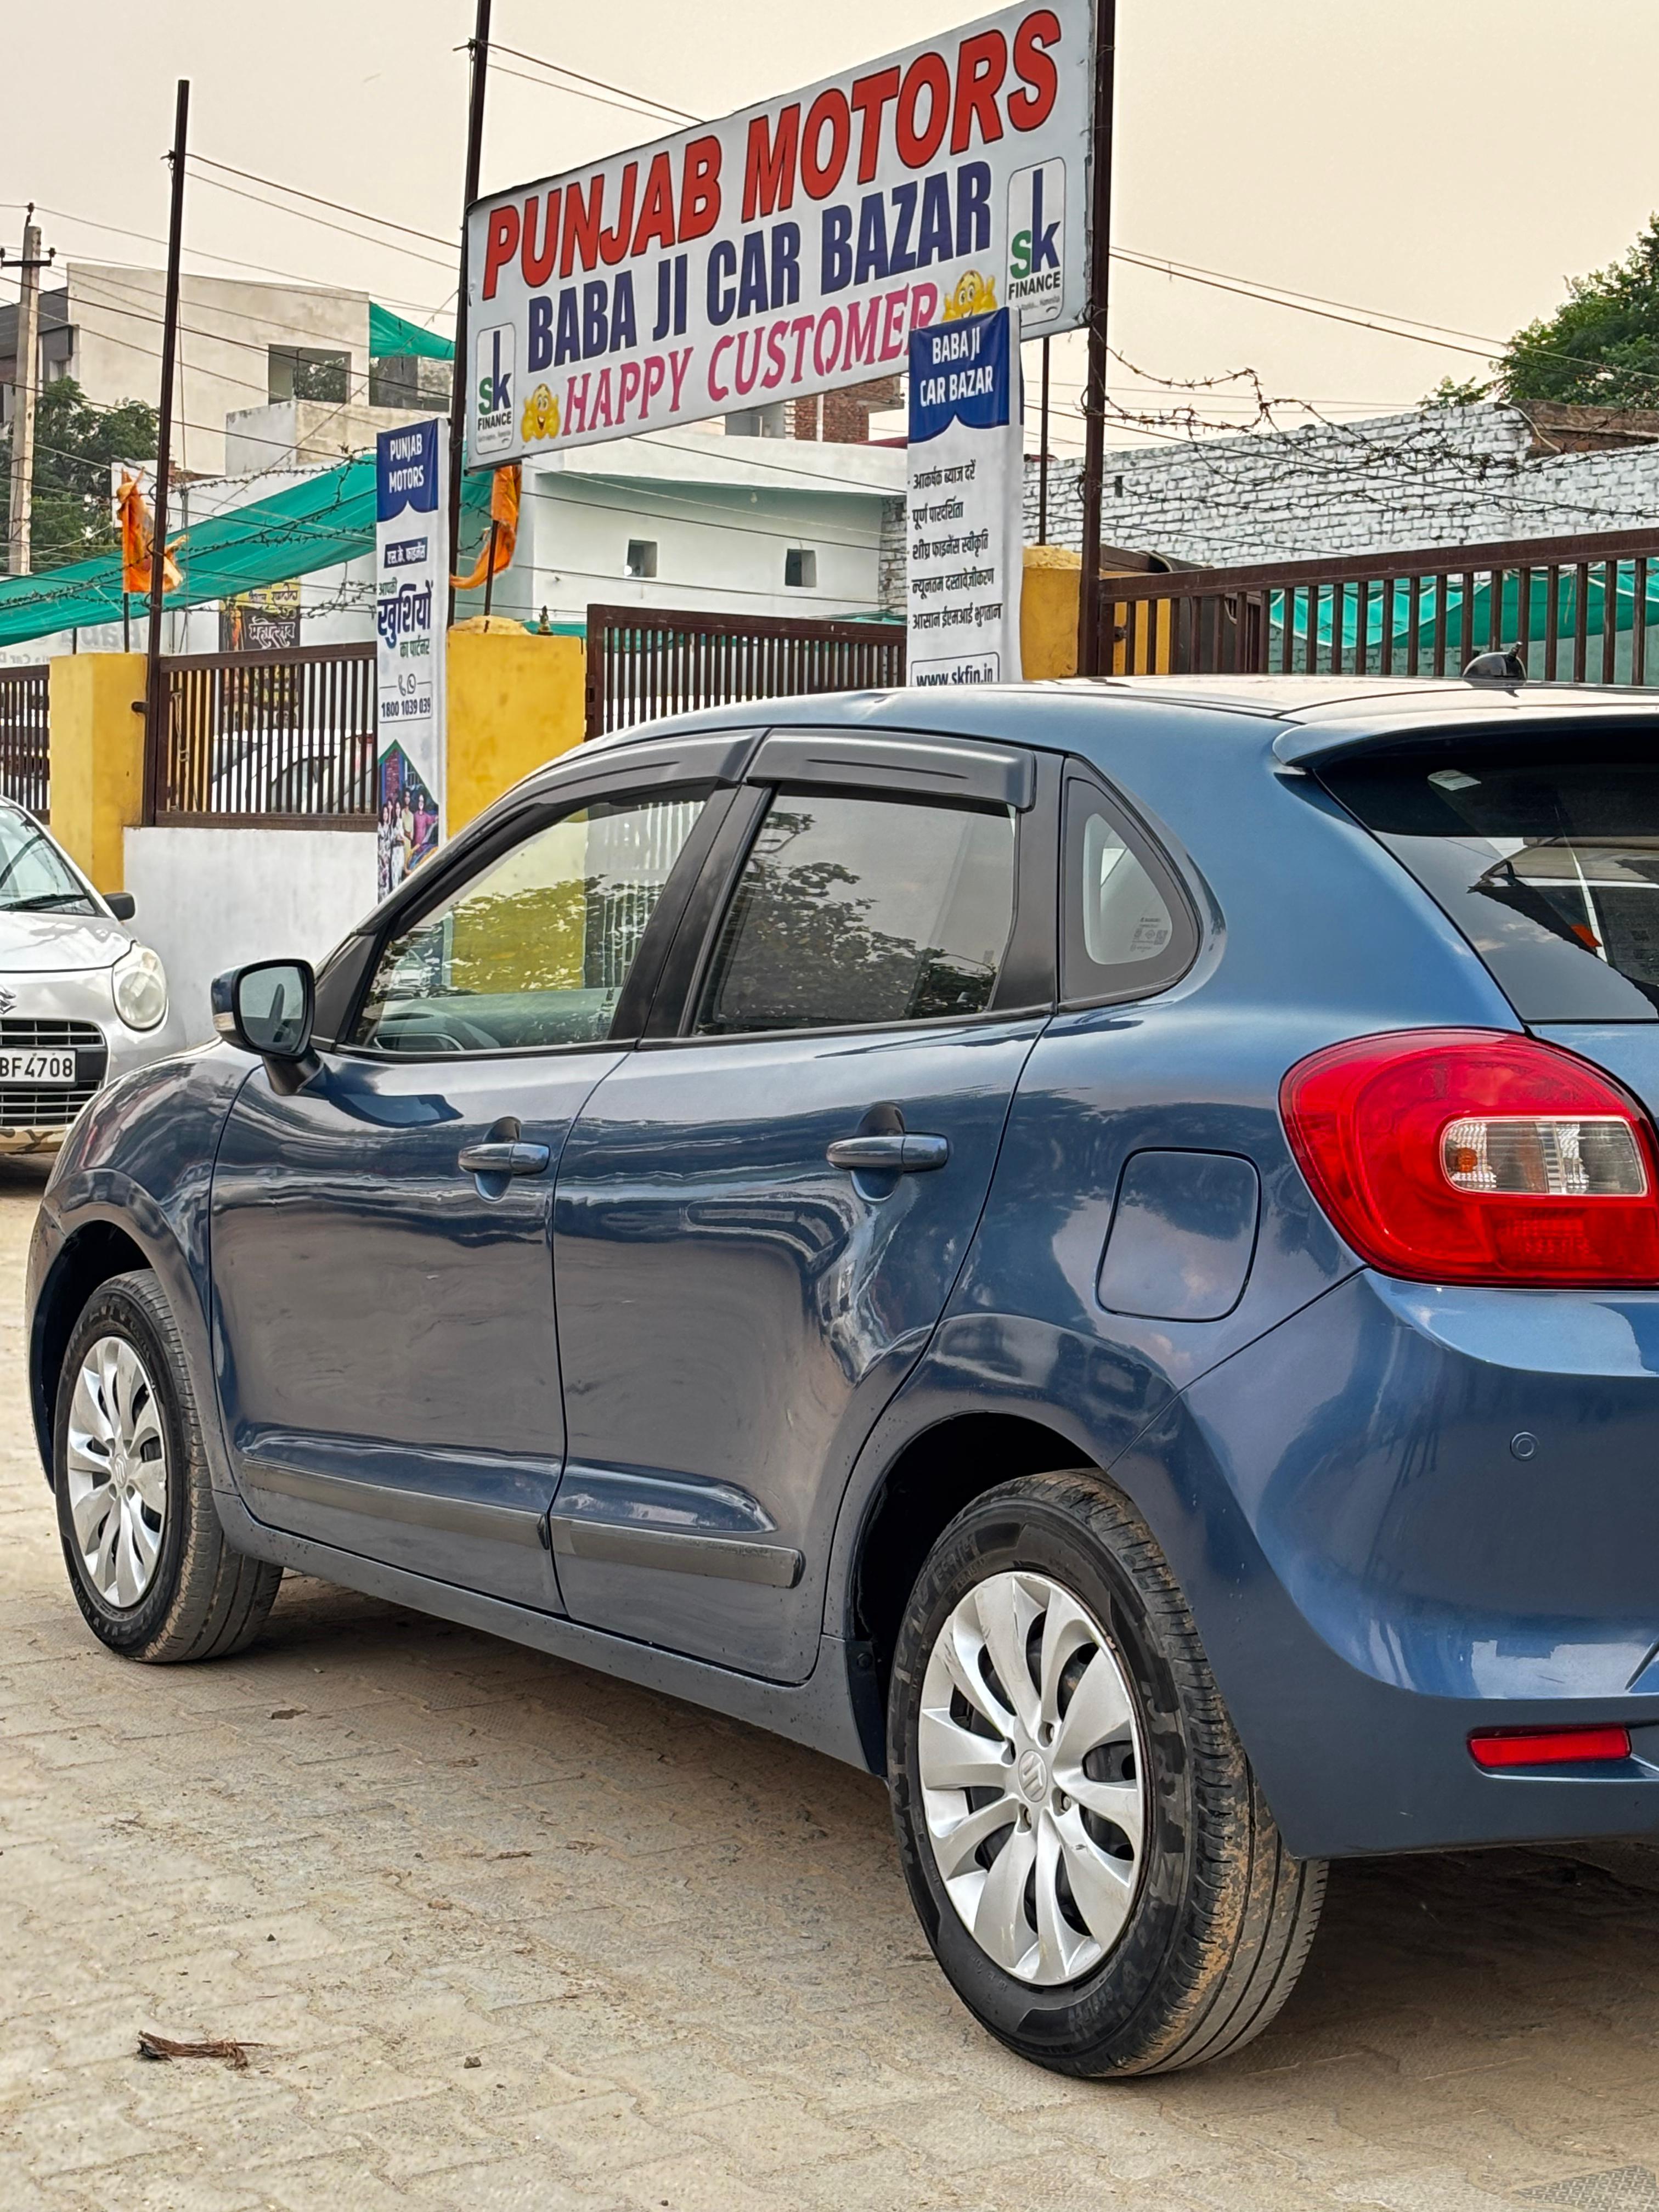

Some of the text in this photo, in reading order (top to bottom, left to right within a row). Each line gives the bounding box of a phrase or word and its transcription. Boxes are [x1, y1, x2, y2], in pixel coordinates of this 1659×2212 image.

[483, 9, 1061, 300] PUNJAB MOTORS
[528, 161, 991, 373] BABA JI CAR BAZAR
[1008, 271, 1060, 300] FINANCE
[933, 326, 980, 364] BABA JI
[561, 347, 695, 436] HAPPY
[920, 366, 993, 407] CAR BAZAR
[477, 411, 511, 431] FINANCE
[390, 433, 422, 461] PUNJAB
[389, 465, 424, 493] MOTORS
[913, 459, 976, 489] आकर्षक ब्याज दरें
[912, 495, 964, 530] पूर्ण पारदर्शिता
[912, 528, 989, 560] शीघ्र फाइनेंस स्वीकृति
[911, 576, 944, 600] न्यूनतम
[377, 579, 433, 649] खुशियों
[912, 602, 1003, 629] आसान ईएमआई भुगतान
[399, 635, 430, 658] का पार्टनर
[381, 697, 431, 718] 1800 1039 039
